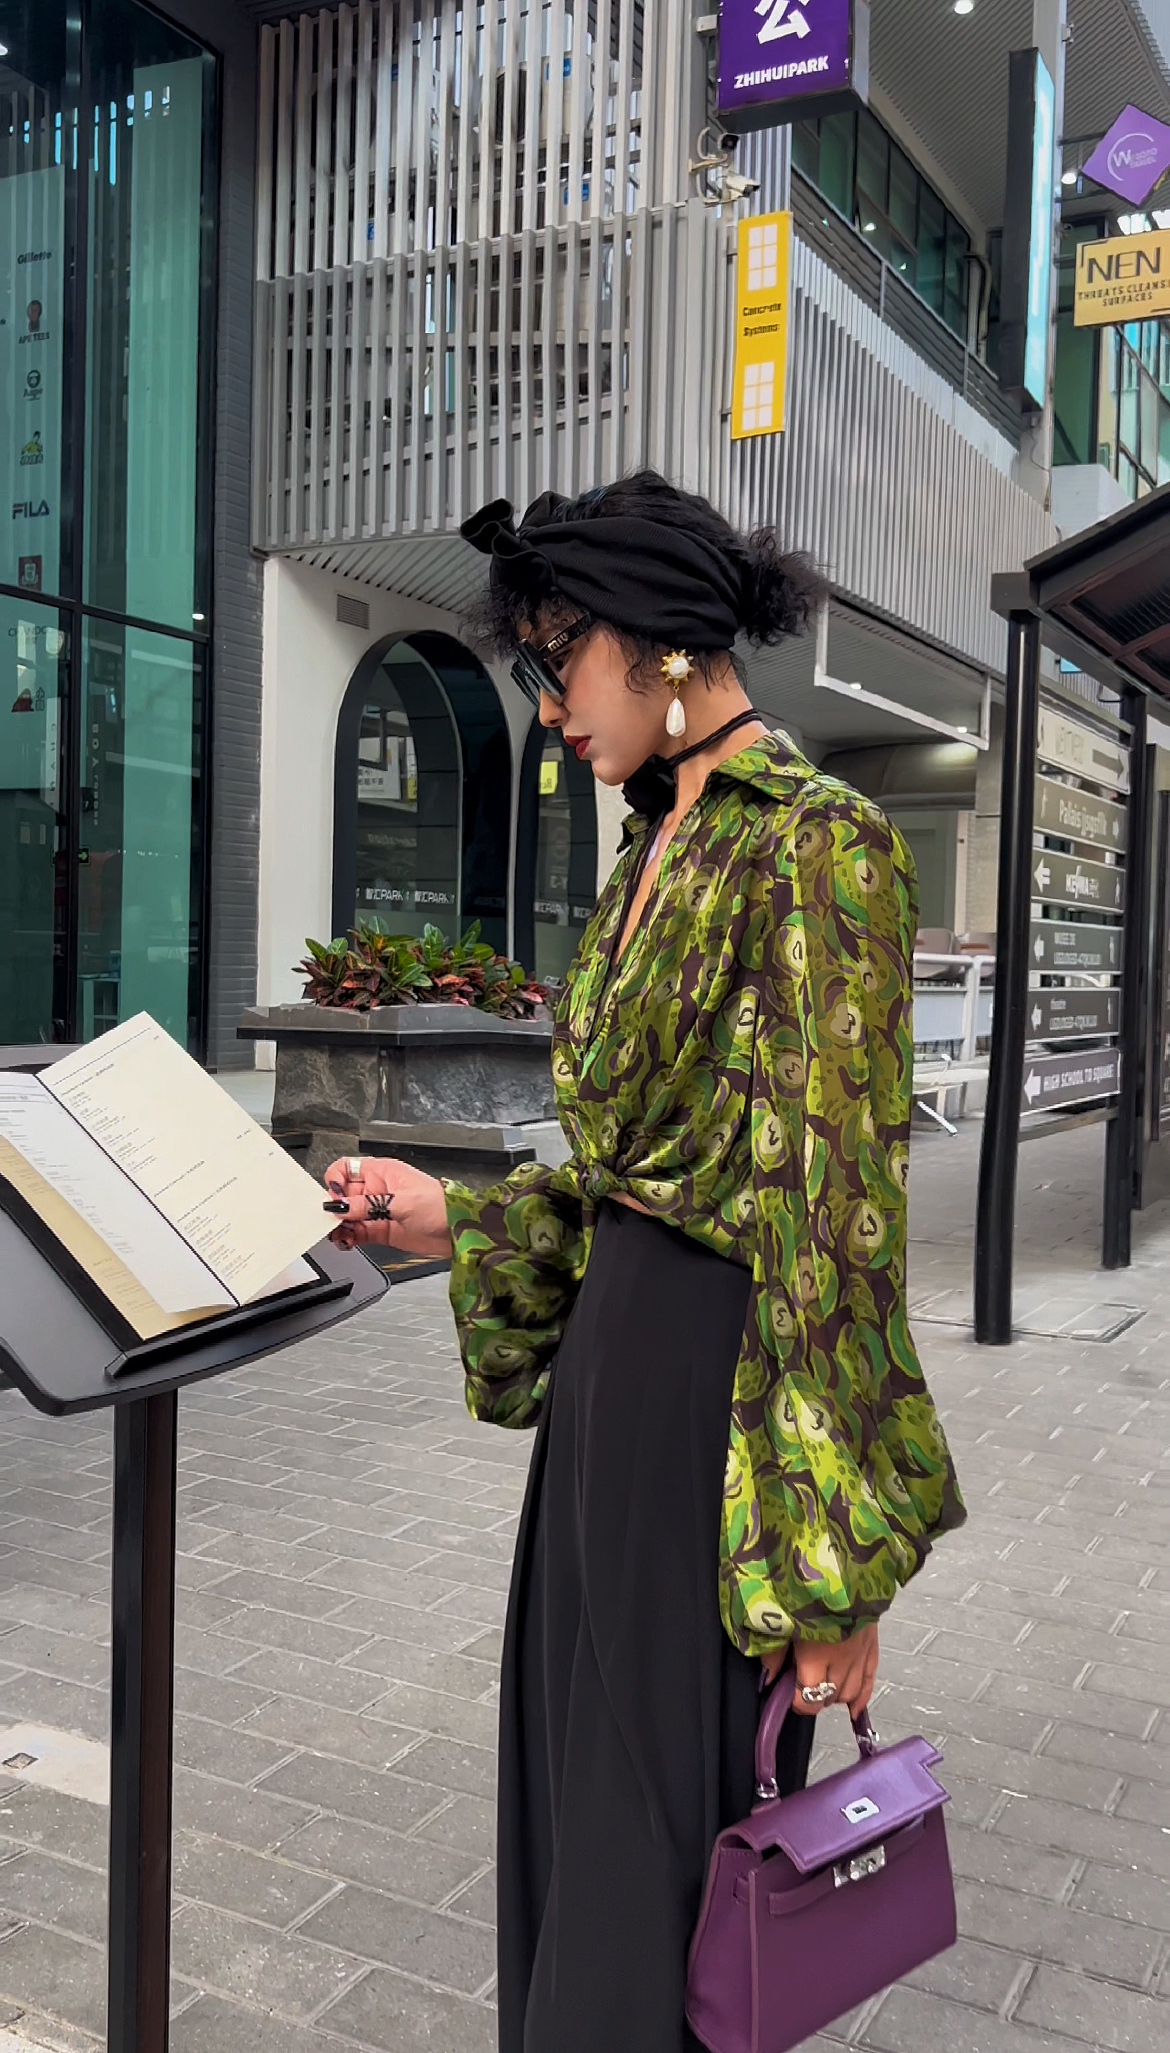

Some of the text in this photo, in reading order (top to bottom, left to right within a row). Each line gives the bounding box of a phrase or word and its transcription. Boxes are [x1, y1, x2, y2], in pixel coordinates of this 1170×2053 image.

[733, 55, 829, 89] ZHIHUIPARK
[1087, 247, 1161, 284] NEN
[12, 500, 50, 519] FILA
